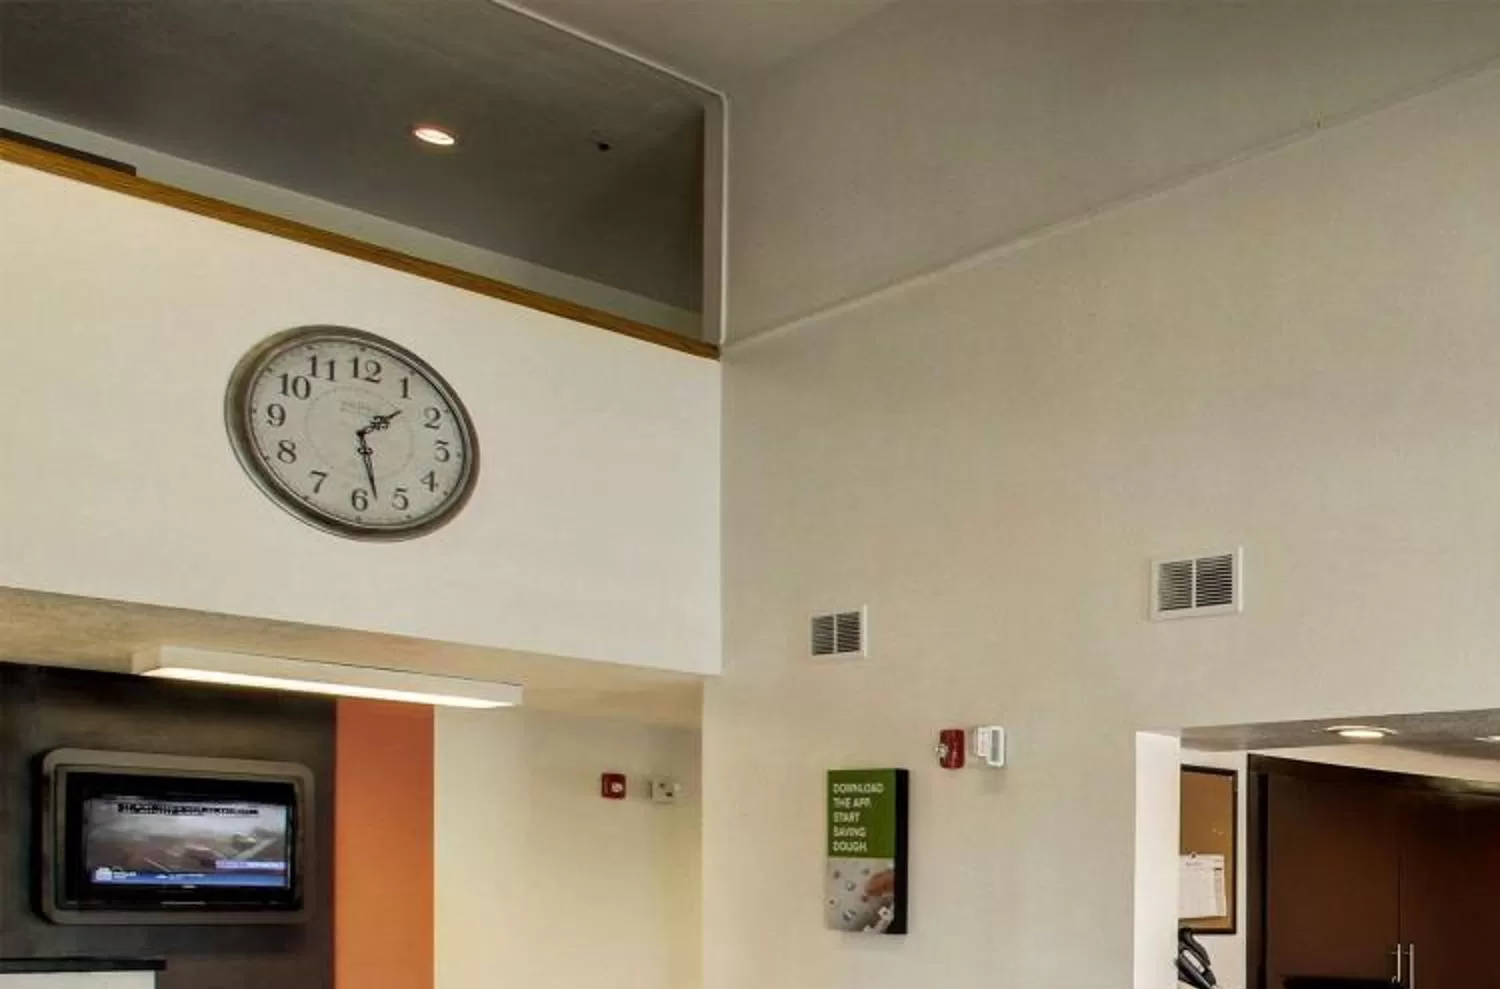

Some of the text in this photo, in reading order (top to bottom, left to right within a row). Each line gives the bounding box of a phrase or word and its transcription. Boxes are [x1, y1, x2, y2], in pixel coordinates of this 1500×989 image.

[309, 355, 337, 382] 11
[349, 356, 383, 384] 12
[279, 373, 311, 400] 10
[401, 378, 413, 400] 1
[267, 403, 286, 427] 9
[424, 407, 442, 430] 2
[277, 439, 297, 464] 8
[434, 440, 450, 463] 3
[310, 470, 329, 494] 7
[421, 471, 439, 492] 4
[351, 488, 369, 512] 6
[391, 488, 409, 511] 5
[833, 783, 885, 794] DOWNLOAD
[833, 796, 852, 809] THE
[833, 811, 861, 823] START
[833, 825, 867, 837] SAVING
